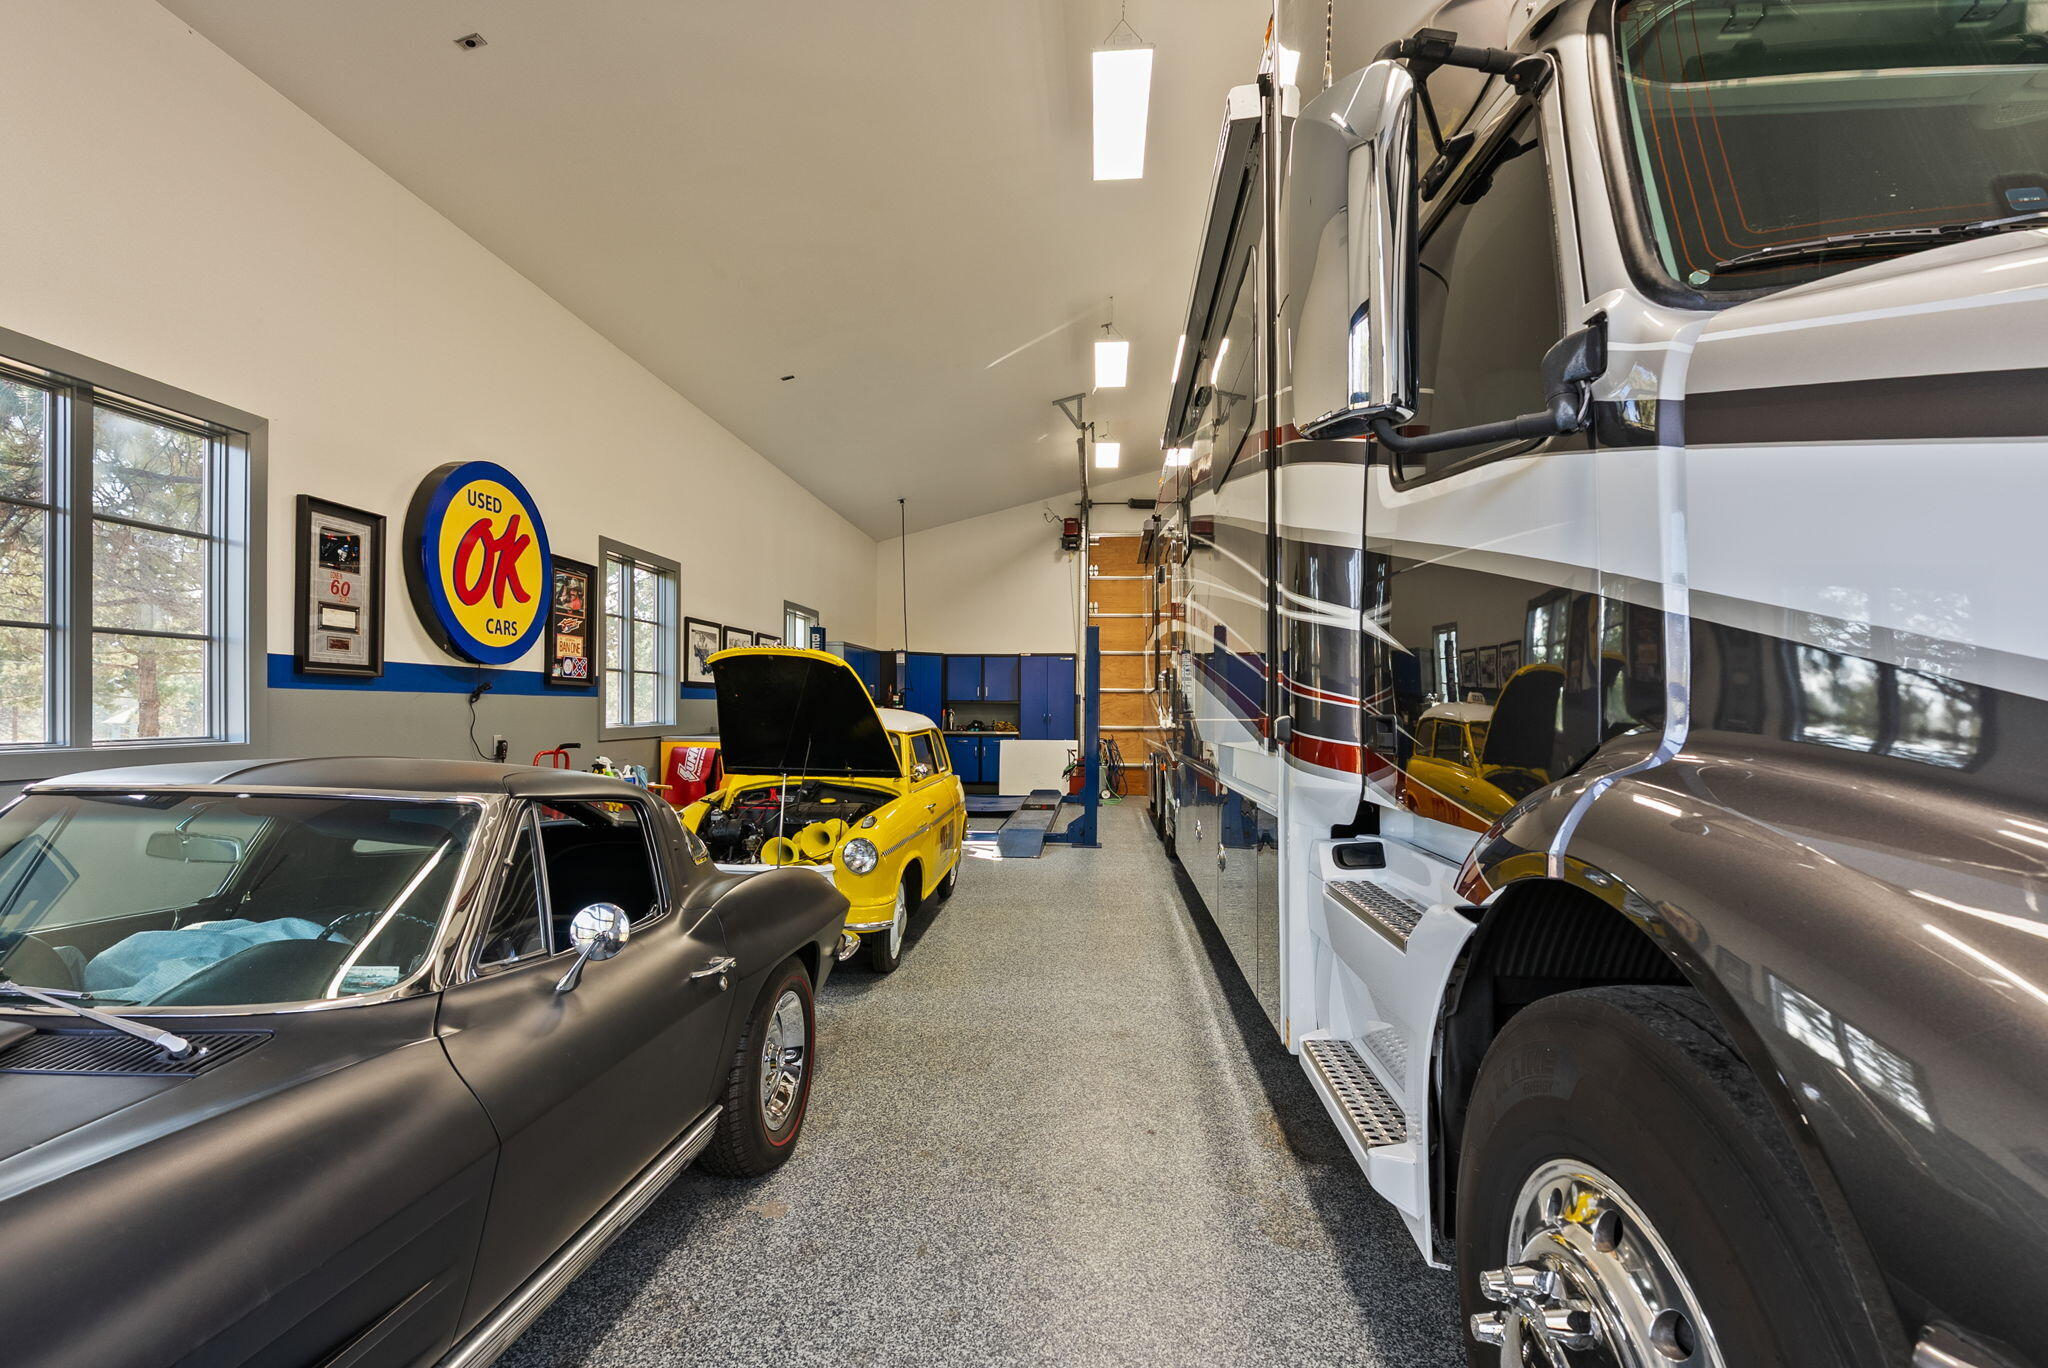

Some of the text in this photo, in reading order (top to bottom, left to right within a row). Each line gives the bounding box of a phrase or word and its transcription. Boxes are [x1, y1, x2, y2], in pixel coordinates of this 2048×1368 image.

[467, 489, 502, 513] USED
[453, 514, 531, 608] OK
[330, 579, 351, 597] 60
[485, 618, 518, 636] CARS
